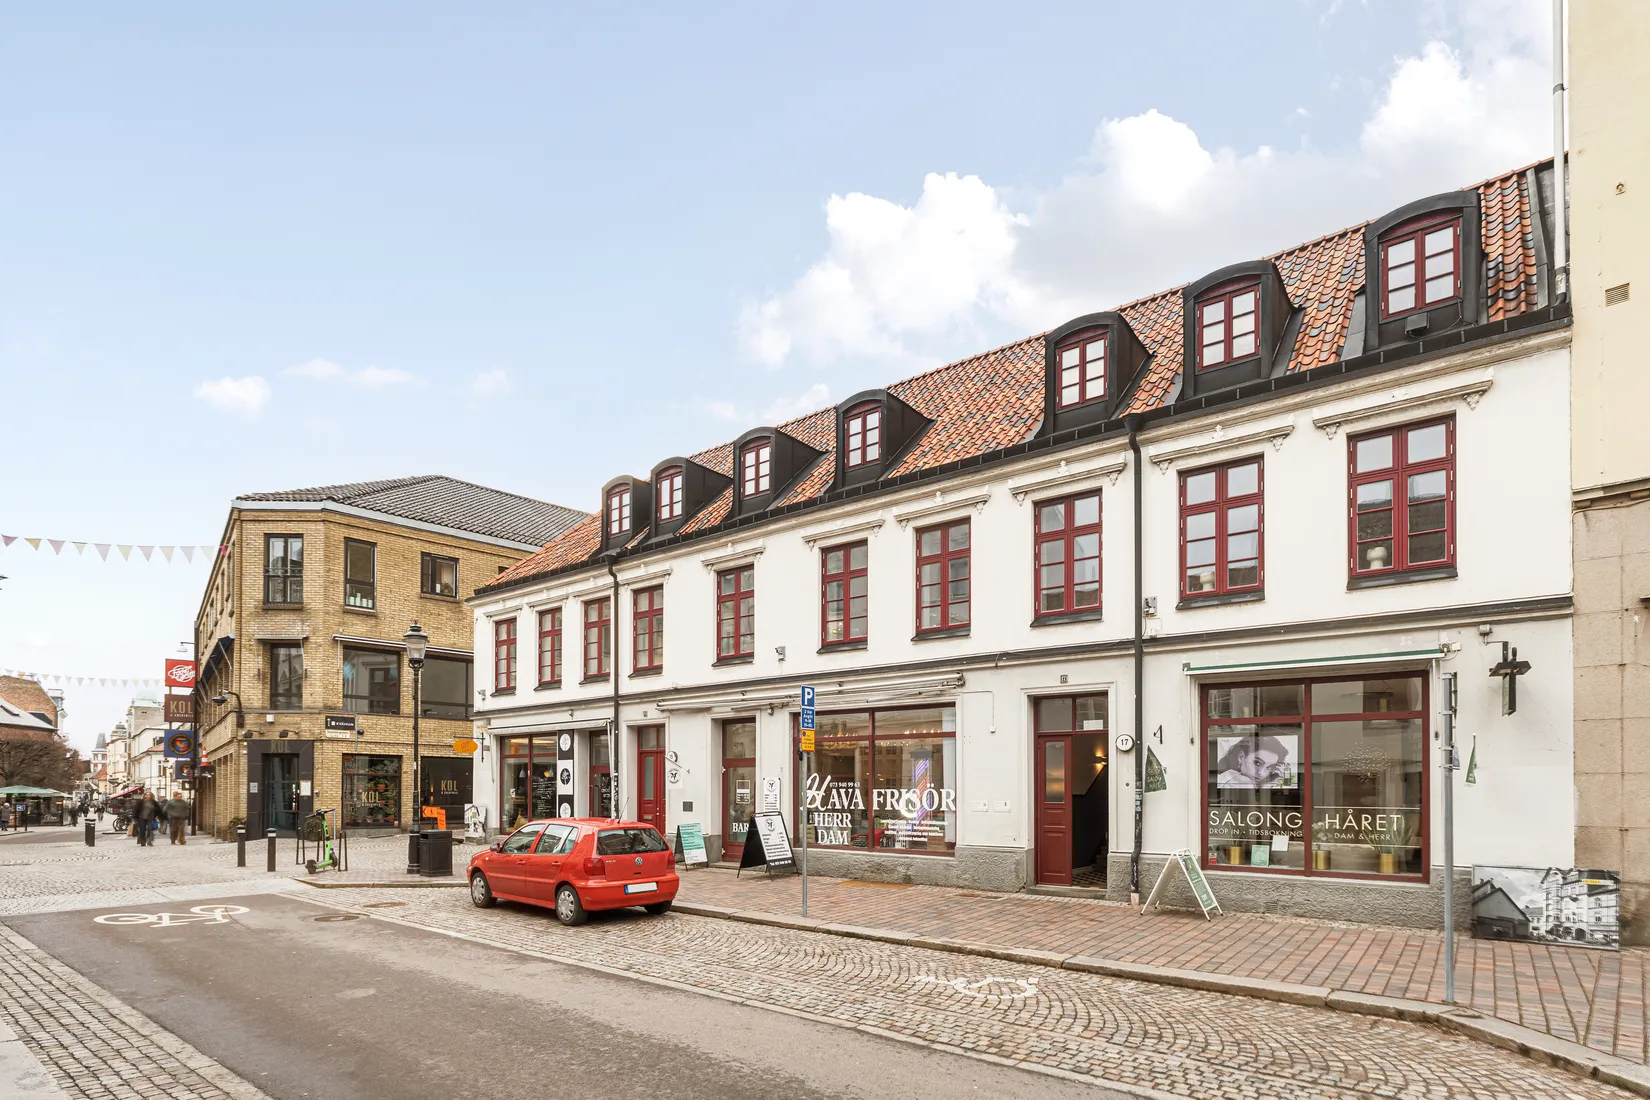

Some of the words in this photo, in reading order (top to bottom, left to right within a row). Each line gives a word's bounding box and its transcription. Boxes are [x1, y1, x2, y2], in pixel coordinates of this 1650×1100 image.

[804, 688, 813, 705] P
[170, 700, 194, 713] KOL
[441, 780, 457, 791] KOL
[800, 773, 865, 811] HAVA
[872, 782, 956, 811] FRISÖR
[361, 787, 381, 803] KOL
[813, 812, 852, 828] HERR
[1209, 810, 1303, 828] SALONG
[1325, 808, 1402, 831] HÅRET
[817, 829, 849, 845] DAM
[1249, 829, 1303, 837] TIDSBOKNING
[1368, 833, 1391, 841] HERR
